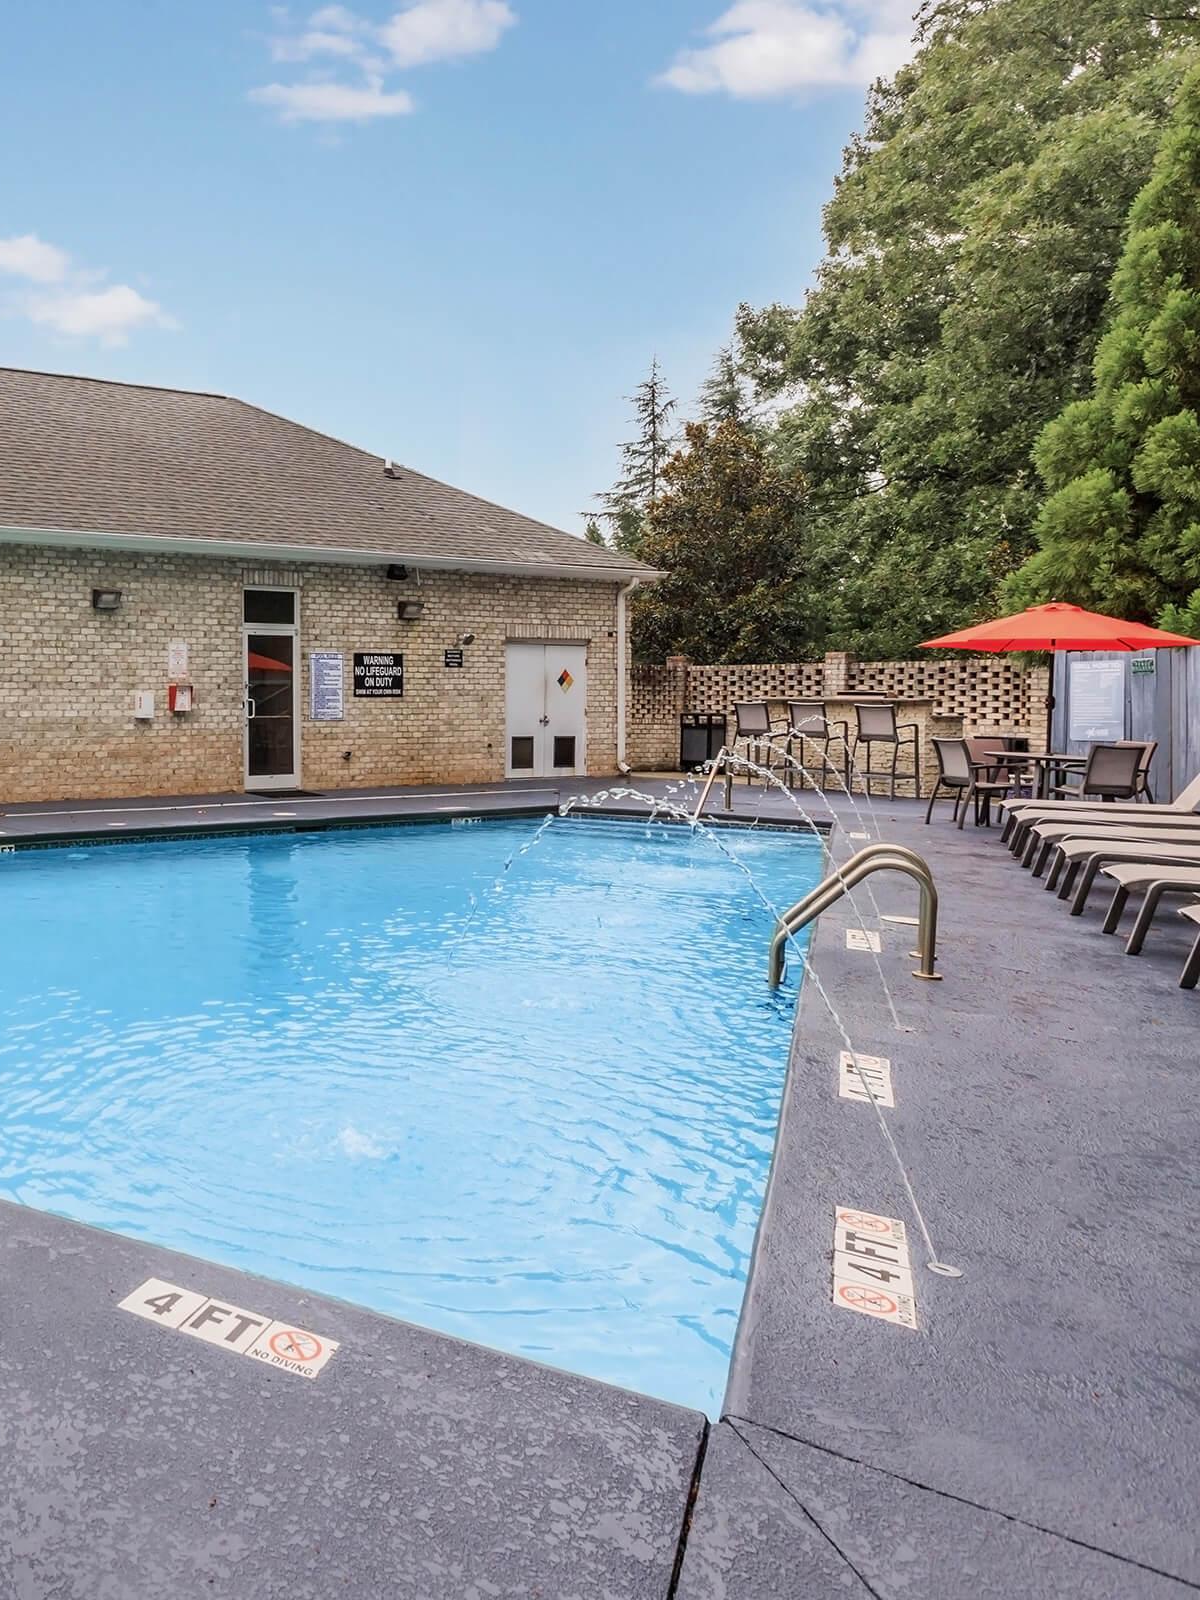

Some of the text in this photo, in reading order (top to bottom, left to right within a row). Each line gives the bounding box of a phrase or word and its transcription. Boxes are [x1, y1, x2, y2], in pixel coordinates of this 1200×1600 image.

[363, 656, 394, 665] WARNING
[355, 666, 402, 676] NO LIFEGUARD
[364, 677, 393, 687] ON DUTY
[845, 1231, 901, 1283] 4 FT
[144, 1292, 263, 1344] 4 FT
[251, 1348, 314, 1377] NO DIVING
